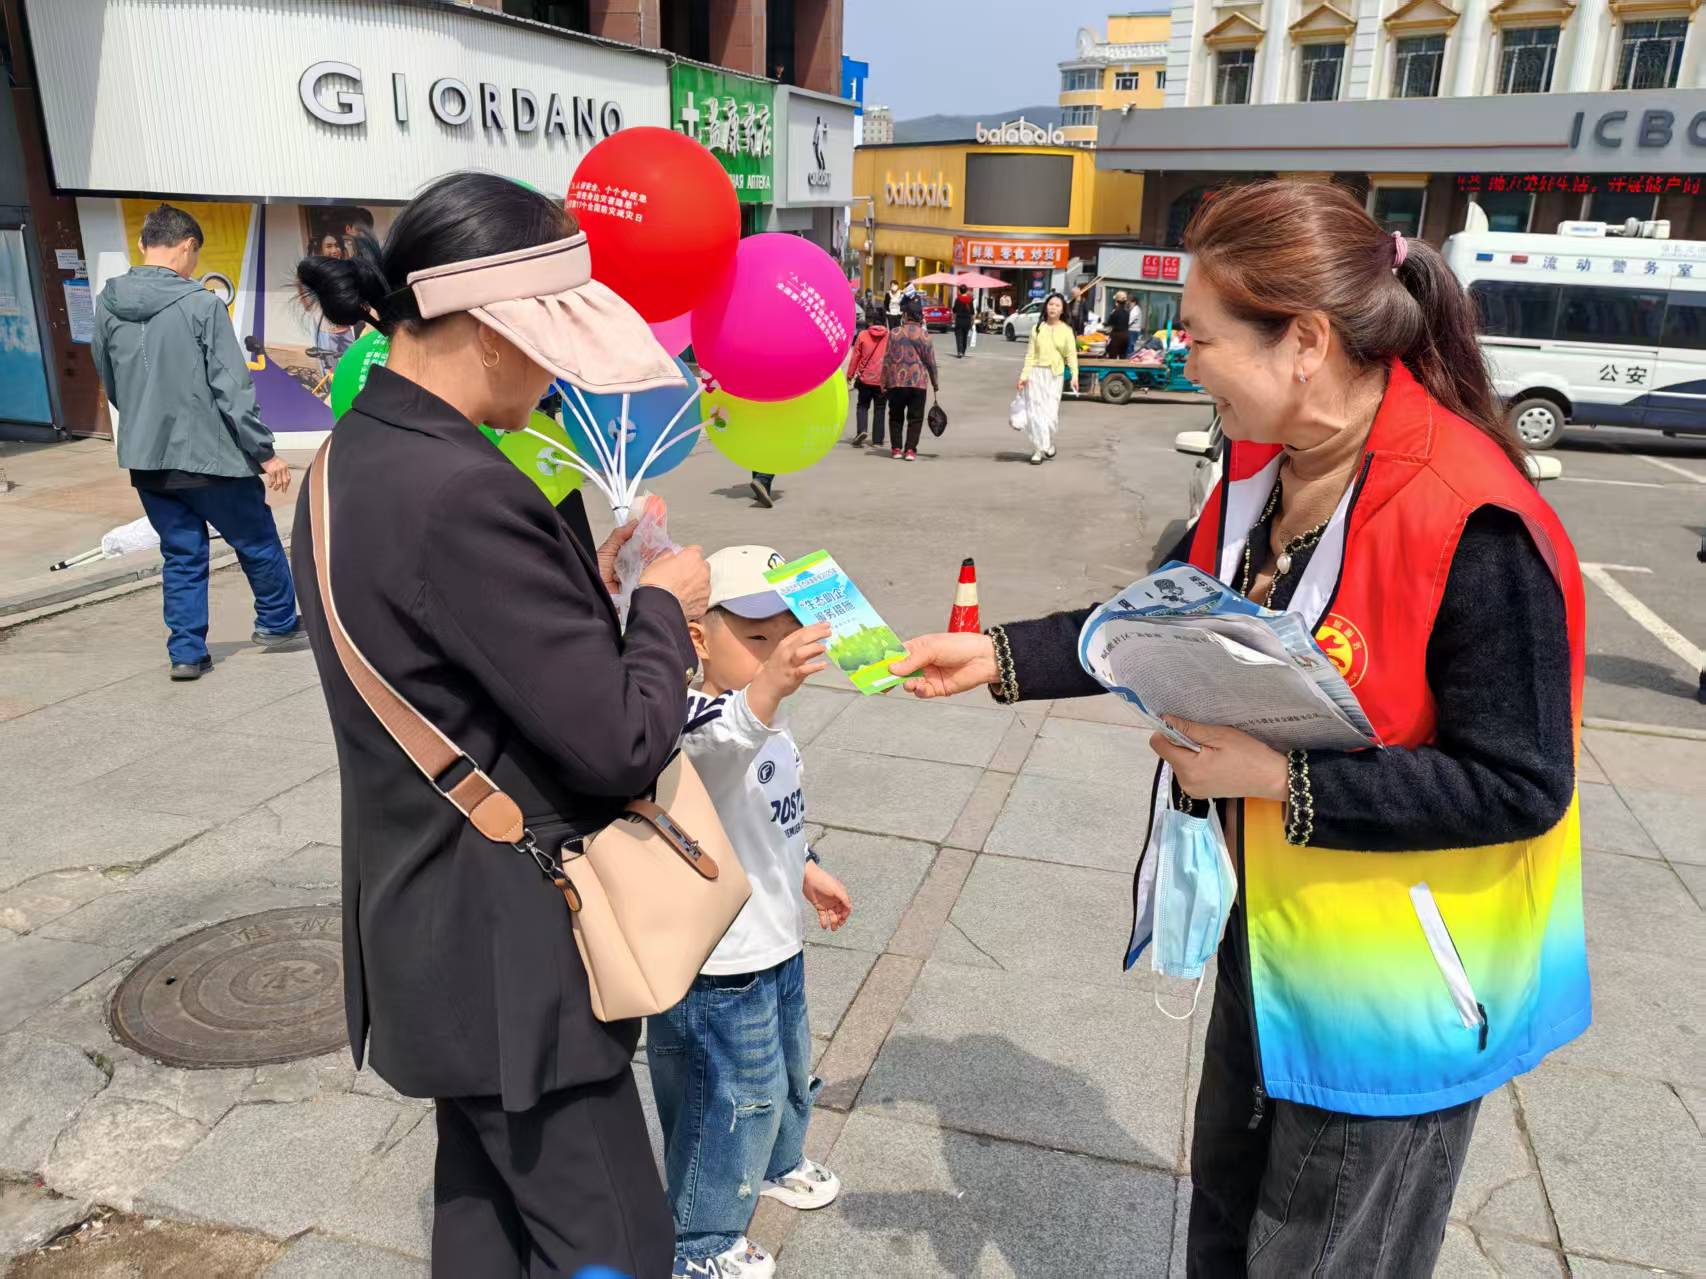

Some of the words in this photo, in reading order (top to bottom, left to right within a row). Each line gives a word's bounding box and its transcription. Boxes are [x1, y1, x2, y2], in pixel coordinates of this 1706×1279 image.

[299, 60, 625, 138] GIORDANO
[976, 116, 1065, 145] balabala
[884, 171, 953, 208] balabala
[1541, 255, 1694, 278] 流动警务室
[1599, 363, 1648, 385] 公安
